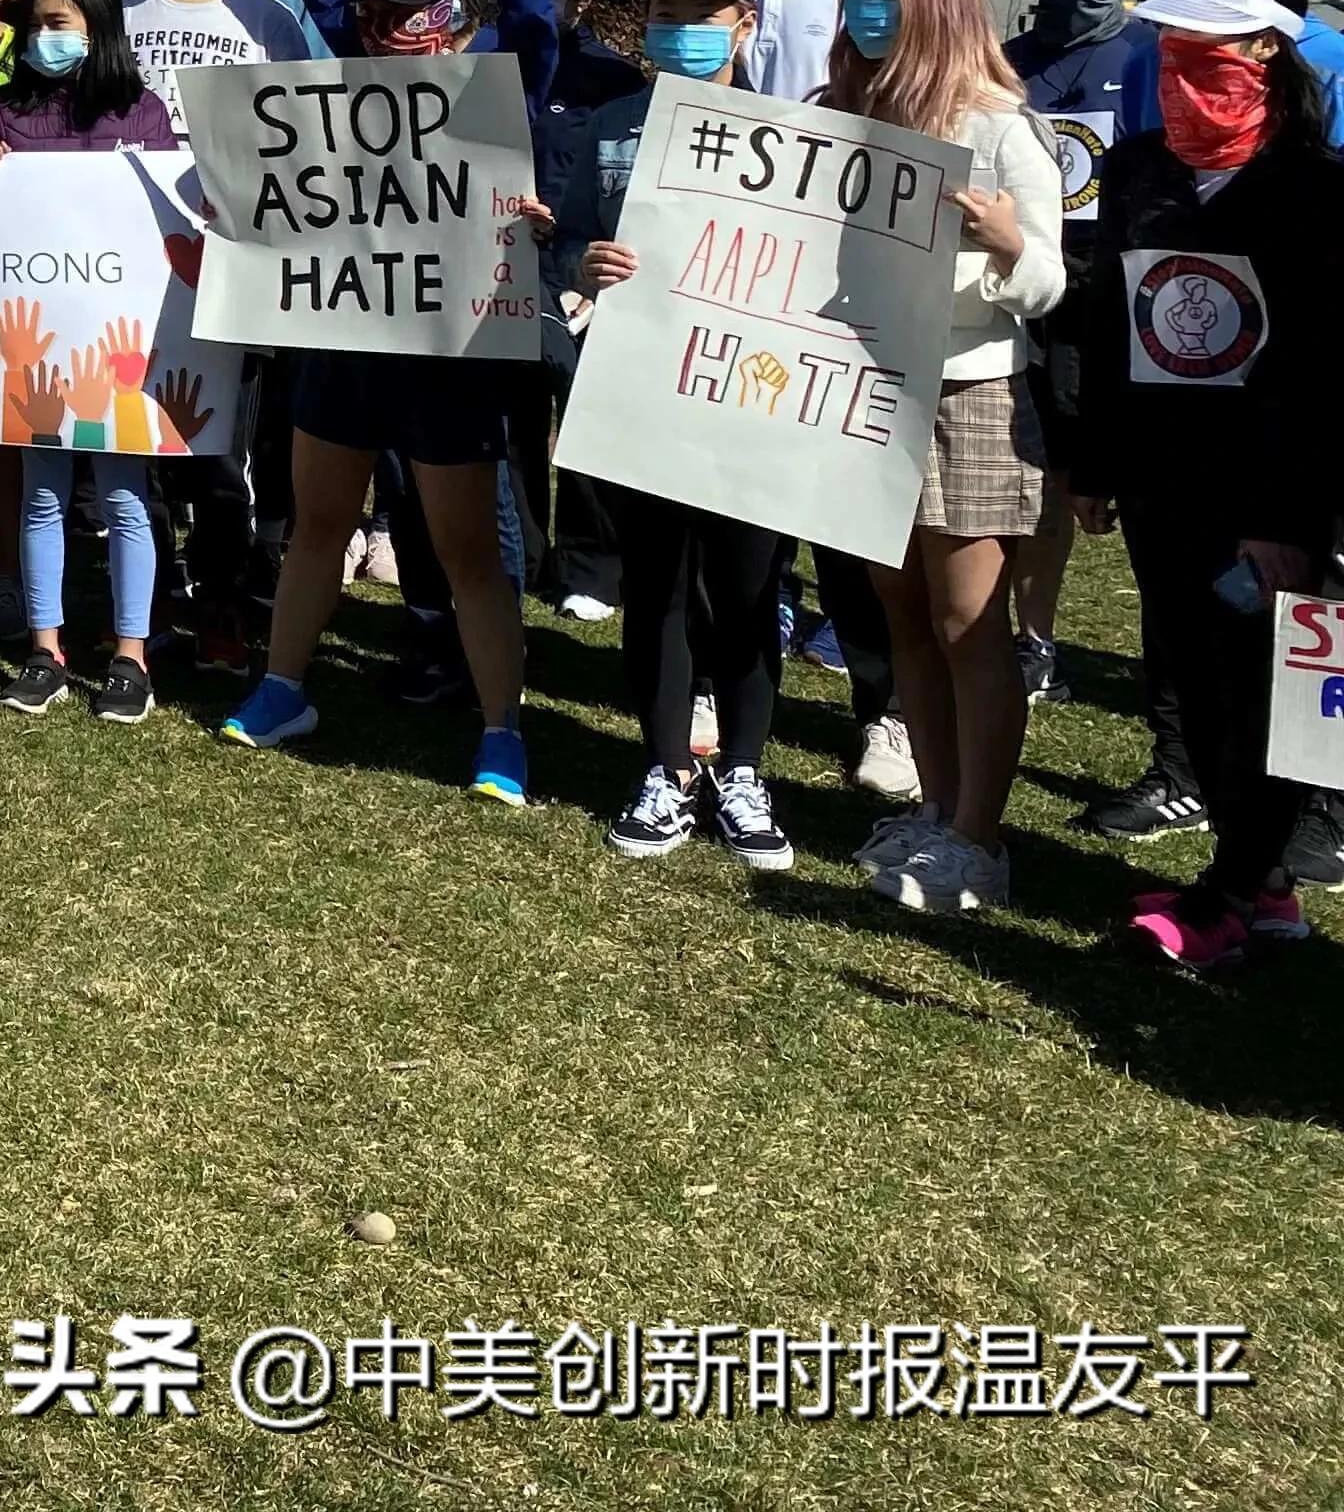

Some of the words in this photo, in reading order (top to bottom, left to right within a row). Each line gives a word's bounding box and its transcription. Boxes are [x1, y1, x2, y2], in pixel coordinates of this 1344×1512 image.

[132, 30, 249, 58] BERCROMBIE
[151, 49, 203, 65] FITCH
[253, 81, 450, 161] STOP
[253, 159, 469, 233] ASIAN
[689, 120, 918, 230] #STOP
[492, 187, 526, 218] hat
[495, 227, 516, 246] is
[280, 252, 443, 316] HATE
[493, 261, 513, 285] a
[677, 219, 809, 314] AAPI
[470, 294, 535, 320] virus
[1290, 603, 1344, 658] S
